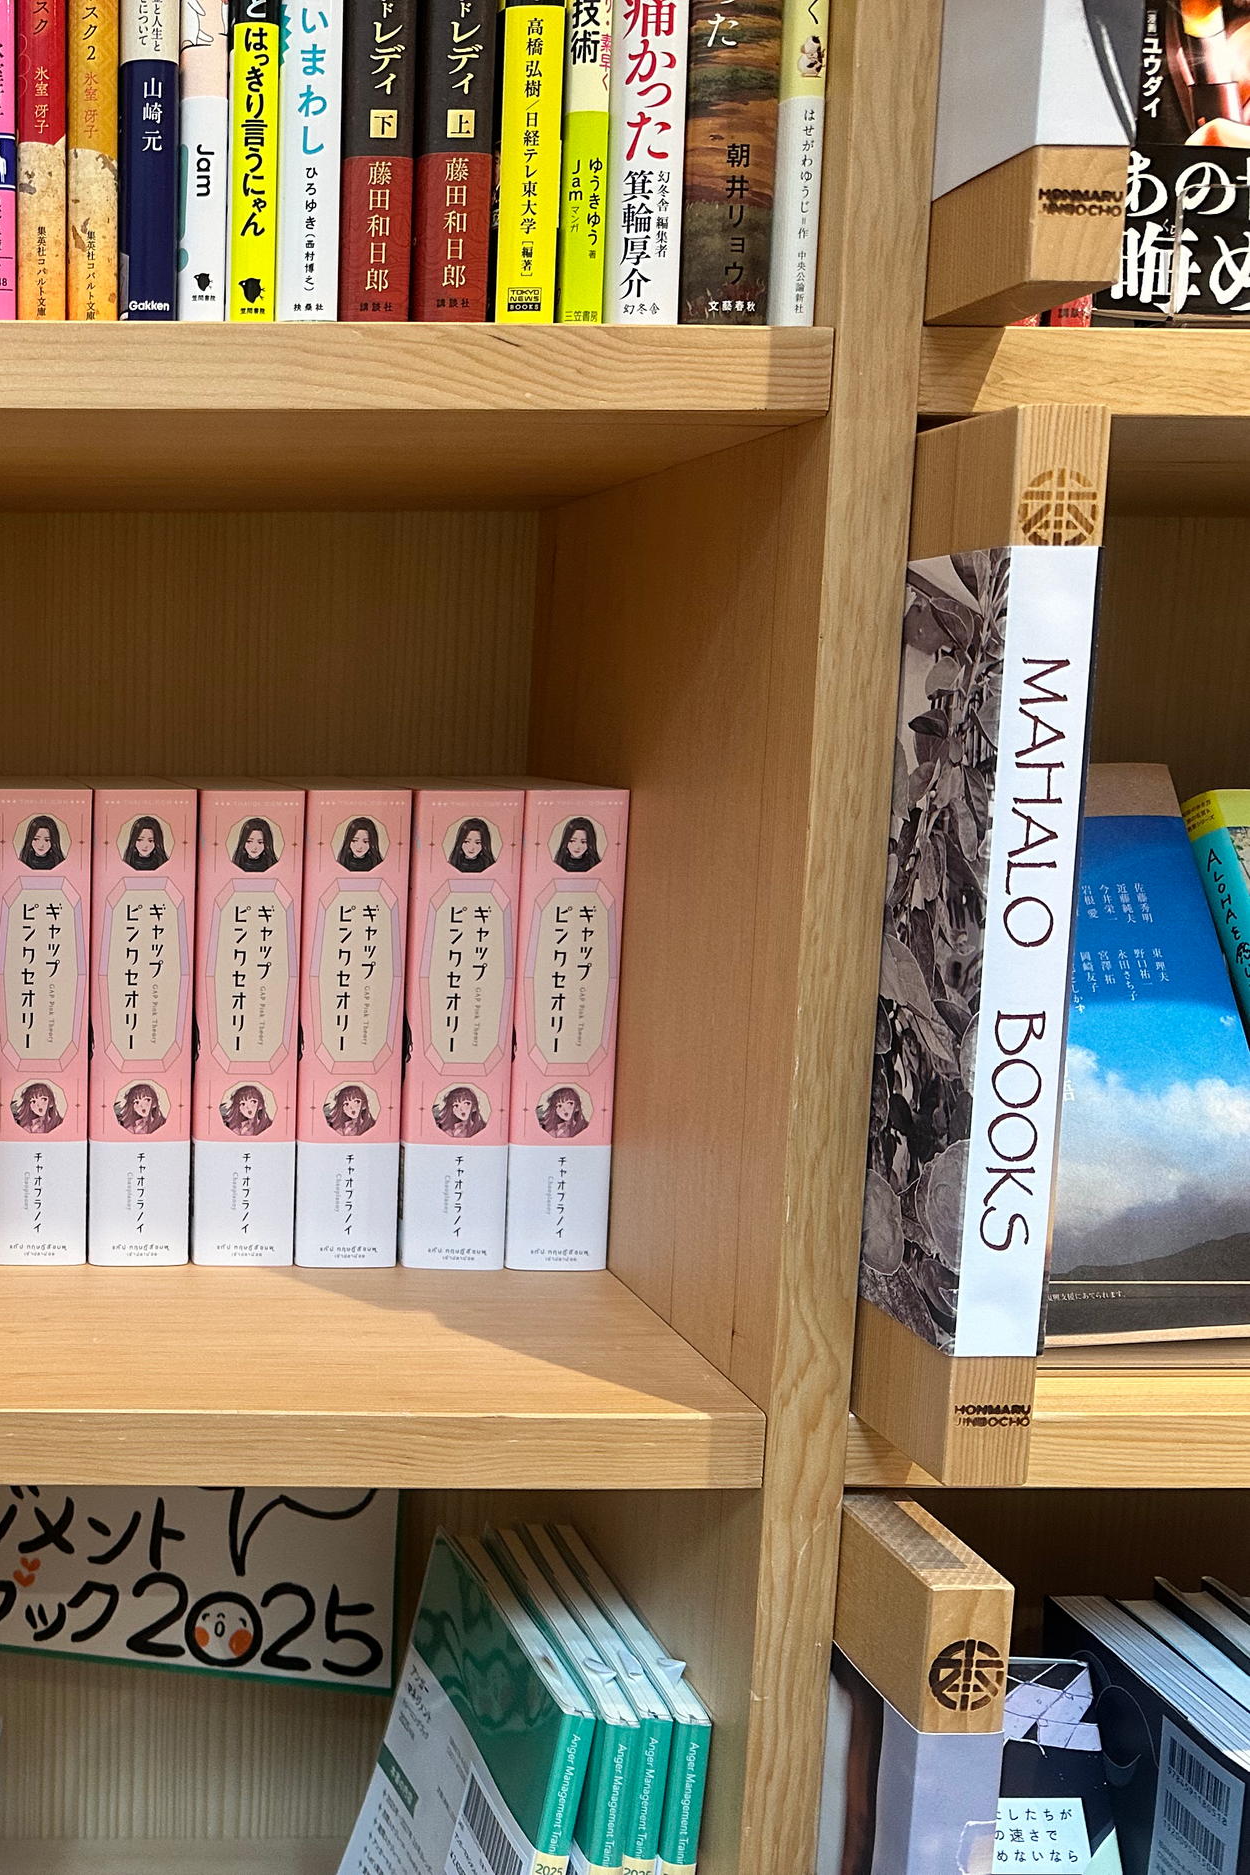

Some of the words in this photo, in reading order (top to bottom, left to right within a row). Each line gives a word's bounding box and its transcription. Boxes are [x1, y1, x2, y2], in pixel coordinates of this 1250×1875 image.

[570, 0, 601, 65] 技術
[297, 7, 329, 156] いまわし
[622, 0, 676, 162] 痛かった
[1141, 37, 1164, 119] ユウダイ
[141, 77, 164, 153] 山崎元
[240, 27, 270, 238] はっきり言うにゃん
[372, 113, 394, 136] 下
[450, 114, 471, 135] 上
[196, 144, 216, 199] Jam
[656, 170, 670, 212] 幻冬舎
[364, 161, 393, 293] 藤田和日郎
[442, 158, 470, 289] 藤田和日郎
[587, 157, 603, 246] ゆうきゆう
[723, 142, 751, 285] 朝井リョウ
[619, 170, 654, 300] 箕輪厚介
[655, 217, 669, 258] 編集者
[36, 226, 48, 317] 集英社コバルト文庫
[85, 230, 97, 321] 集英社コバルト文庫
[191, 293, 217, 303] 笠間書院
[509, 288, 541, 297] TOKYO
[793, 252, 807, 314] 中央公論新社
[128, 299, 171, 313] Gakken
[239, 307, 267, 316] 笠間書院
[293, 303, 325, 313] 扶桑社
[359, 302, 393, 313] 講談社
[436, 298, 471, 309] 講談社
[508, 295, 540, 303] NEWS
[508, 303, 541, 312] BOOKS
[564, 310, 598, 322] 三笠書房
[622, 303, 660, 315] 幻冬舎
[707, 300, 756, 312] 文藝春秋
[1001, 656, 1071, 949] MAHALO
[45, 903, 63, 979] ギャップ
[21, 903, 40, 1049] ピンクセオリー
[1117, 949, 1138, 1001] 永田さち子
[979, 1009, 1047, 1252] BOOKS
[953, 1403, 1032, 1416] HONMARU
[953, 1416, 1032, 1428] JINBOCHO
[566, 1733, 582, 1766] Anger
[554, 1765, 576, 1832] Management
